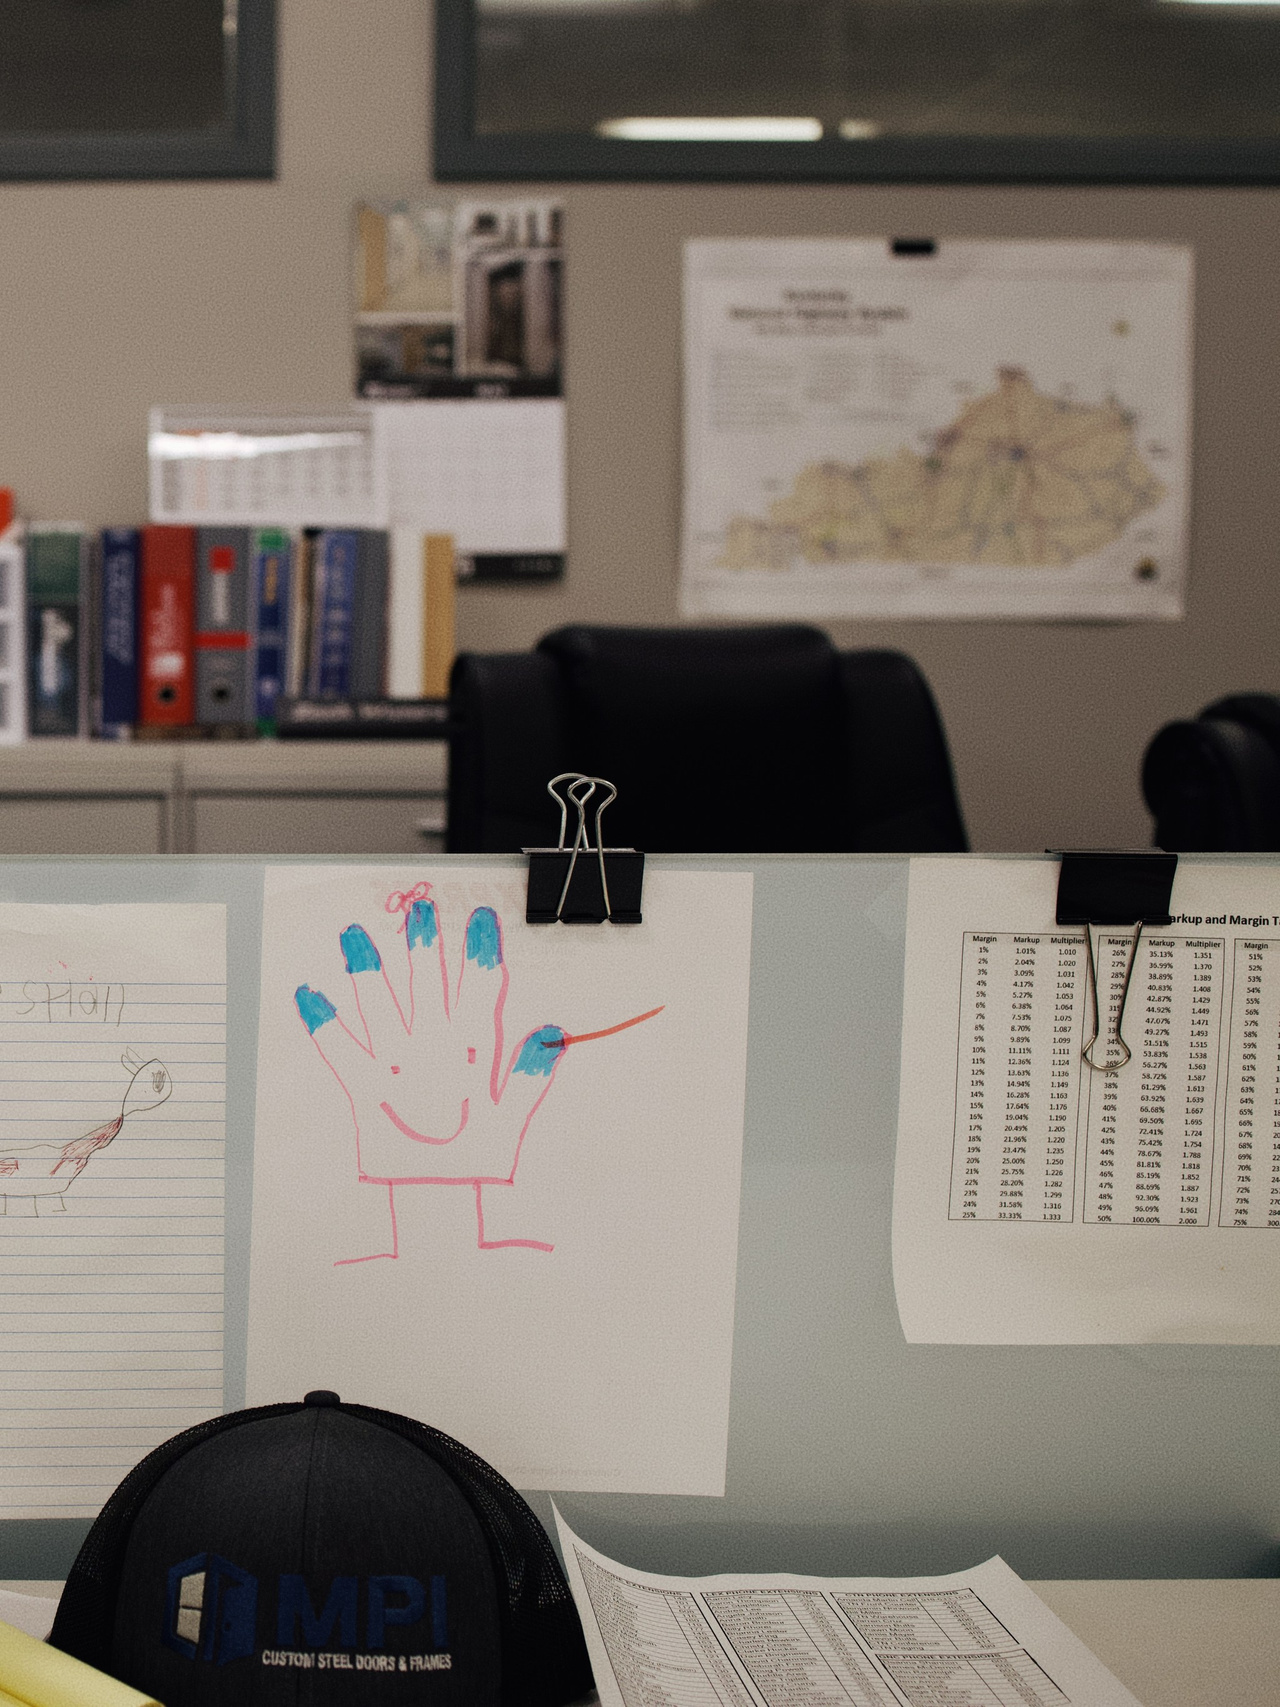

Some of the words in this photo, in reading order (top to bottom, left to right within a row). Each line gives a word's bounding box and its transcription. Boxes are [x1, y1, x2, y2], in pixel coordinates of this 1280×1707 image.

[1171, 914, 1202, 925] arkup
[1206, 915, 1226, 925] and
[1230, 915, 1269, 927] Margin
[973, 935, 997, 943] Margin
[1051, 937, 1086, 945] Multiplier
[1108, 938, 1132, 947] Margin
[277, 1574, 448, 1648] MPI
[262, 1650, 316, 1669] CUSTOM
[318, 1653, 354, 1669] STEEL
[356, 1654, 396, 1671] DOORS
[398, 1655, 408, 1672] &
[410, 1653, 452, 1671] FRAMES
